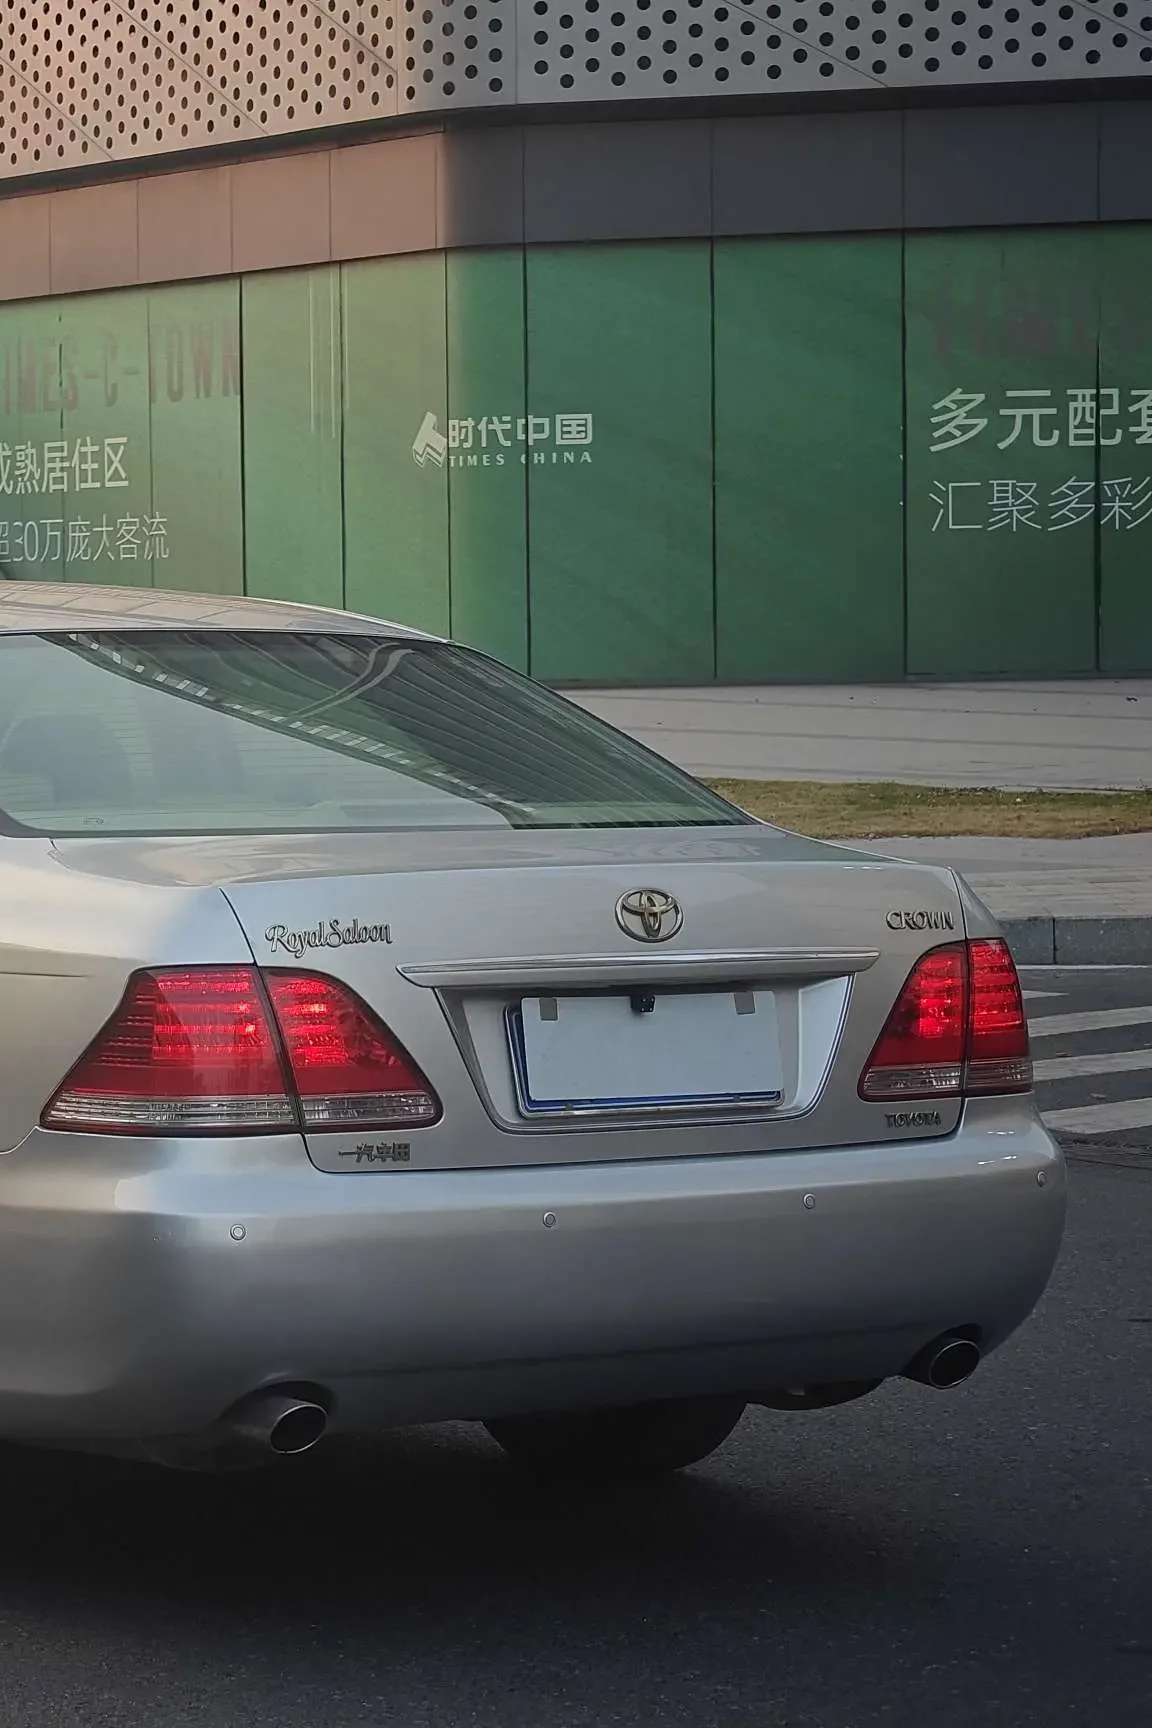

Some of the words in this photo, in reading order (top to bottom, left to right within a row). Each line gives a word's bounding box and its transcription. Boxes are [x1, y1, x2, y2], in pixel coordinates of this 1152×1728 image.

[448, 414, 593, 449] 时代中国
[449, 453, 505, 468] TIMES
[520, 451, 592, 466] CHINA
[929, 475, 1152, 532] 汇聚多彩
[885, 911, 954, 930] CROWN
[885, 1111, 941, 1128] TOYOTA
